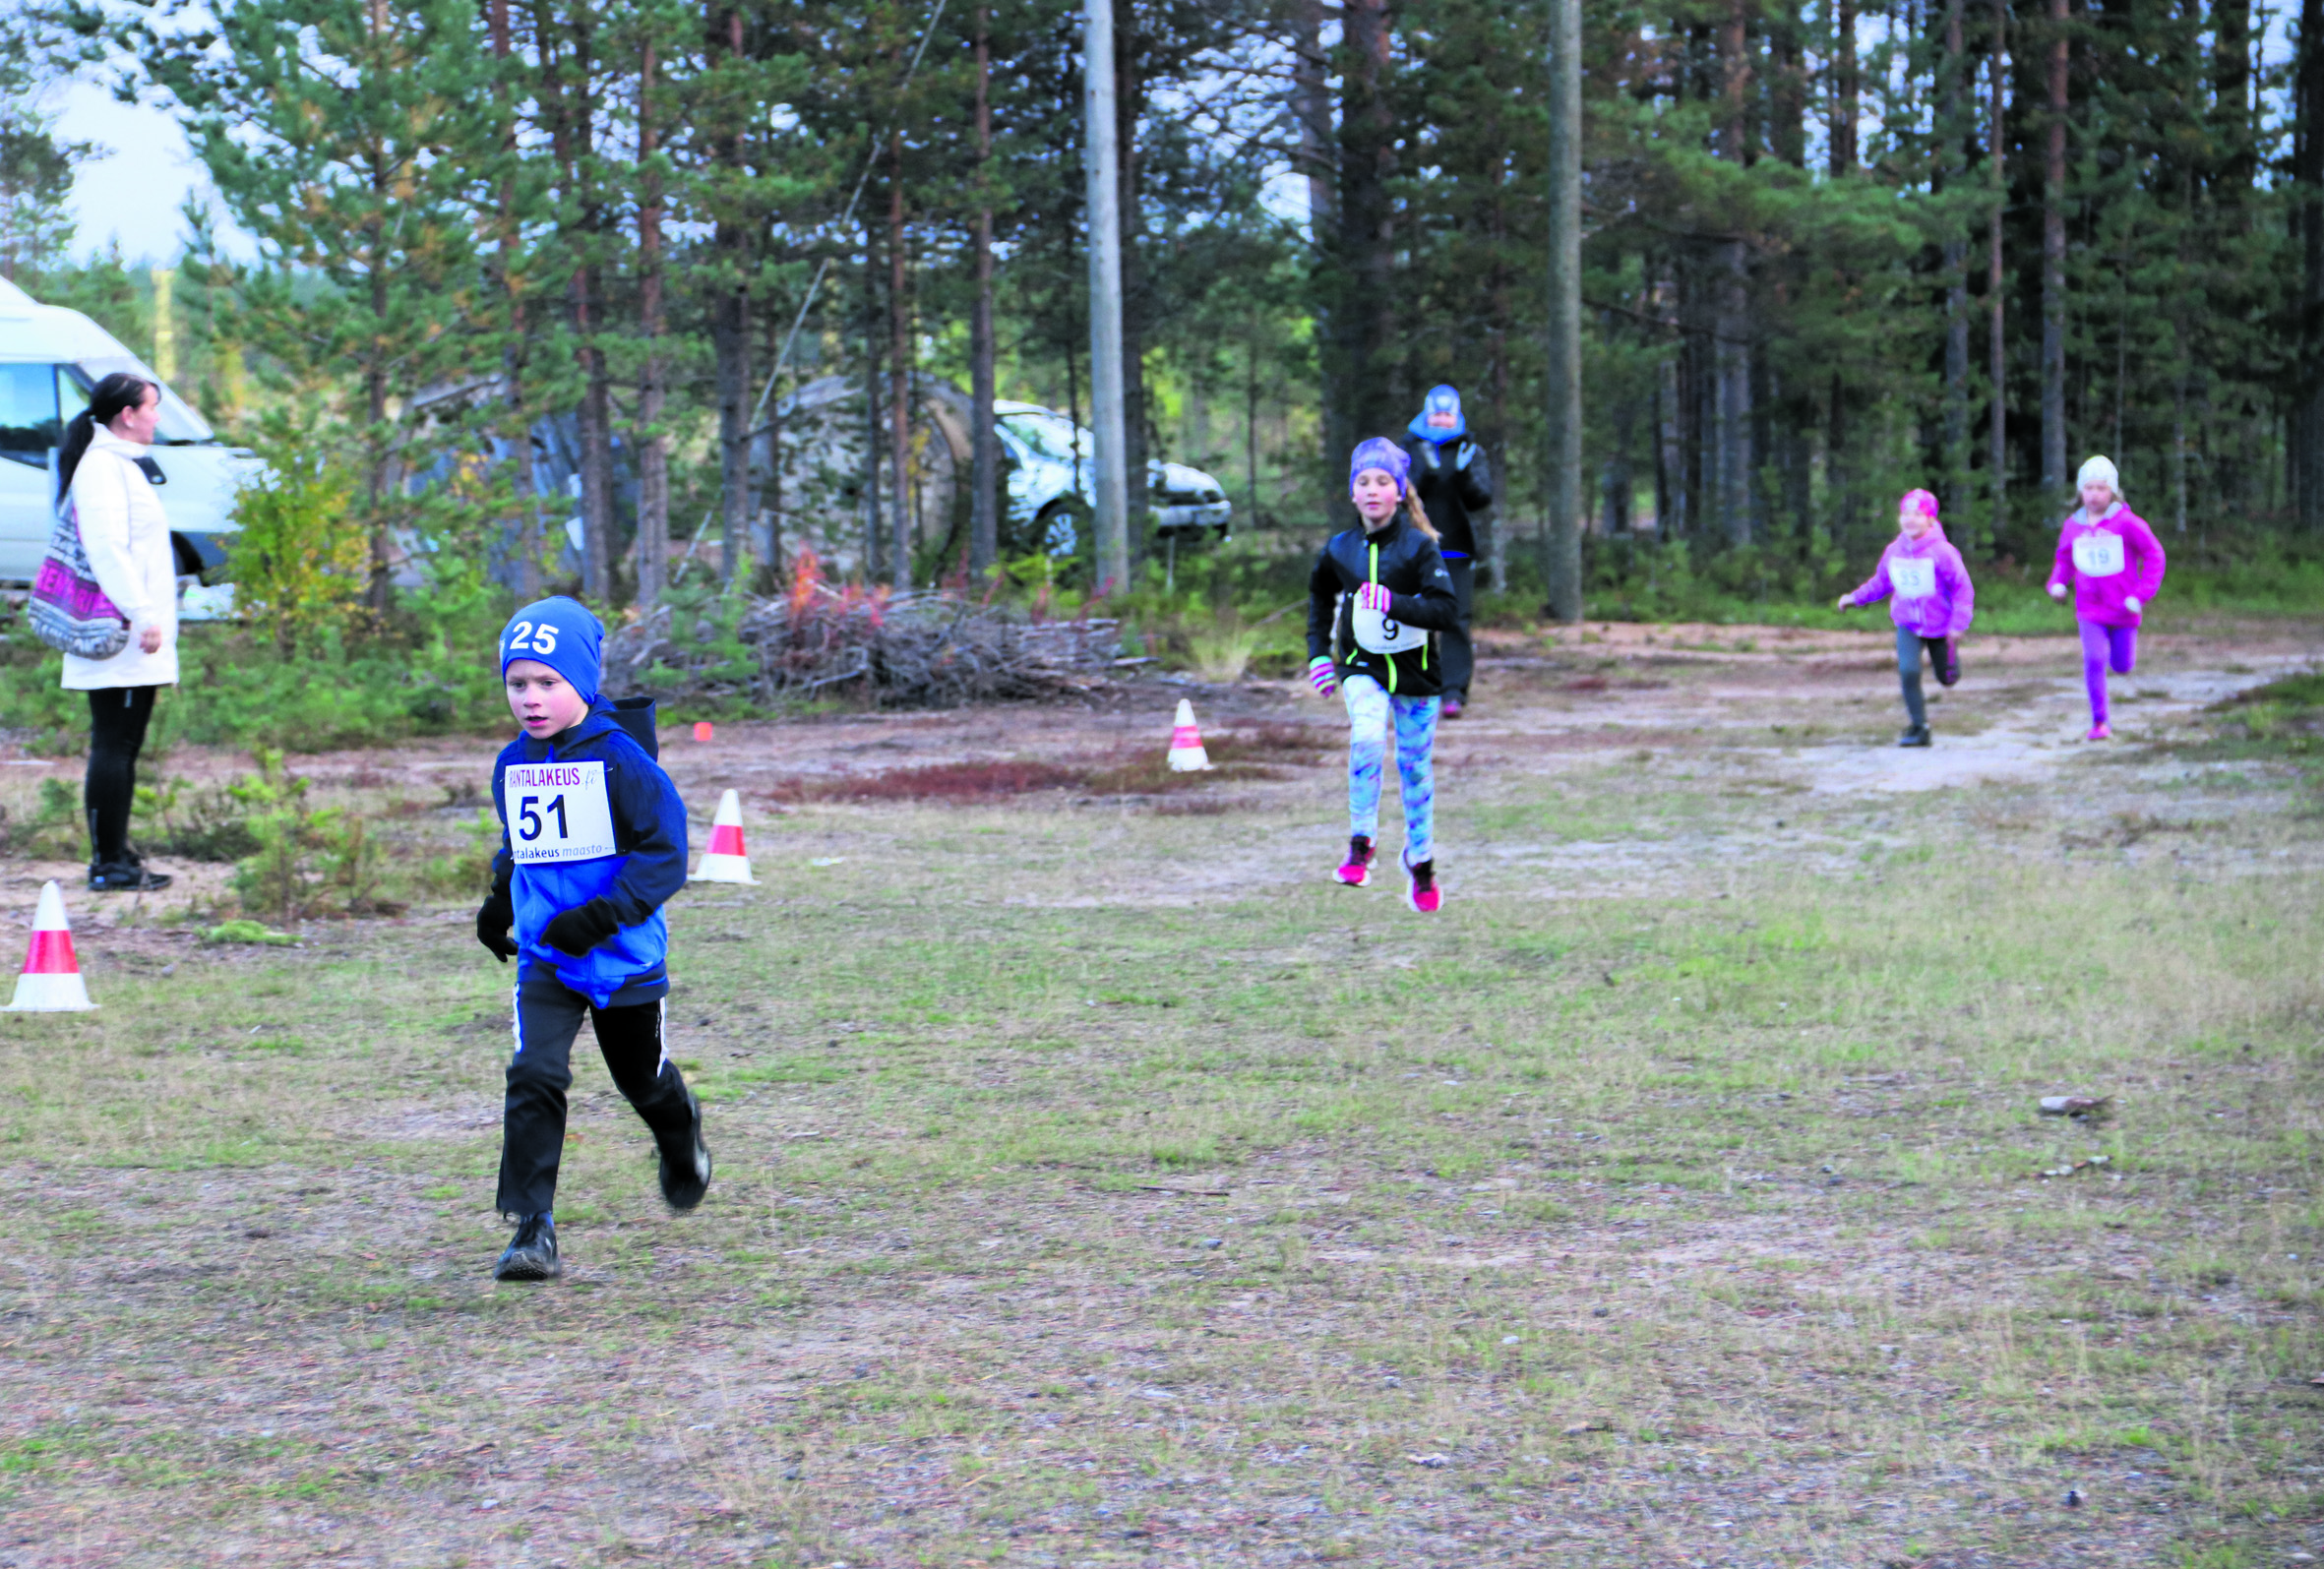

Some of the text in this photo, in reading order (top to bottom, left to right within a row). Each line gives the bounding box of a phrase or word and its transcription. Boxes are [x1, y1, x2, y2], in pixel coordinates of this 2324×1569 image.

[2087, 547, 2110, 566] 19
[510, 621, 560, 655] 25
[1382, 618, 1400, 640] 9
[519, 794, 569, 841] 51
[562, 844, 603, 858] maasto
